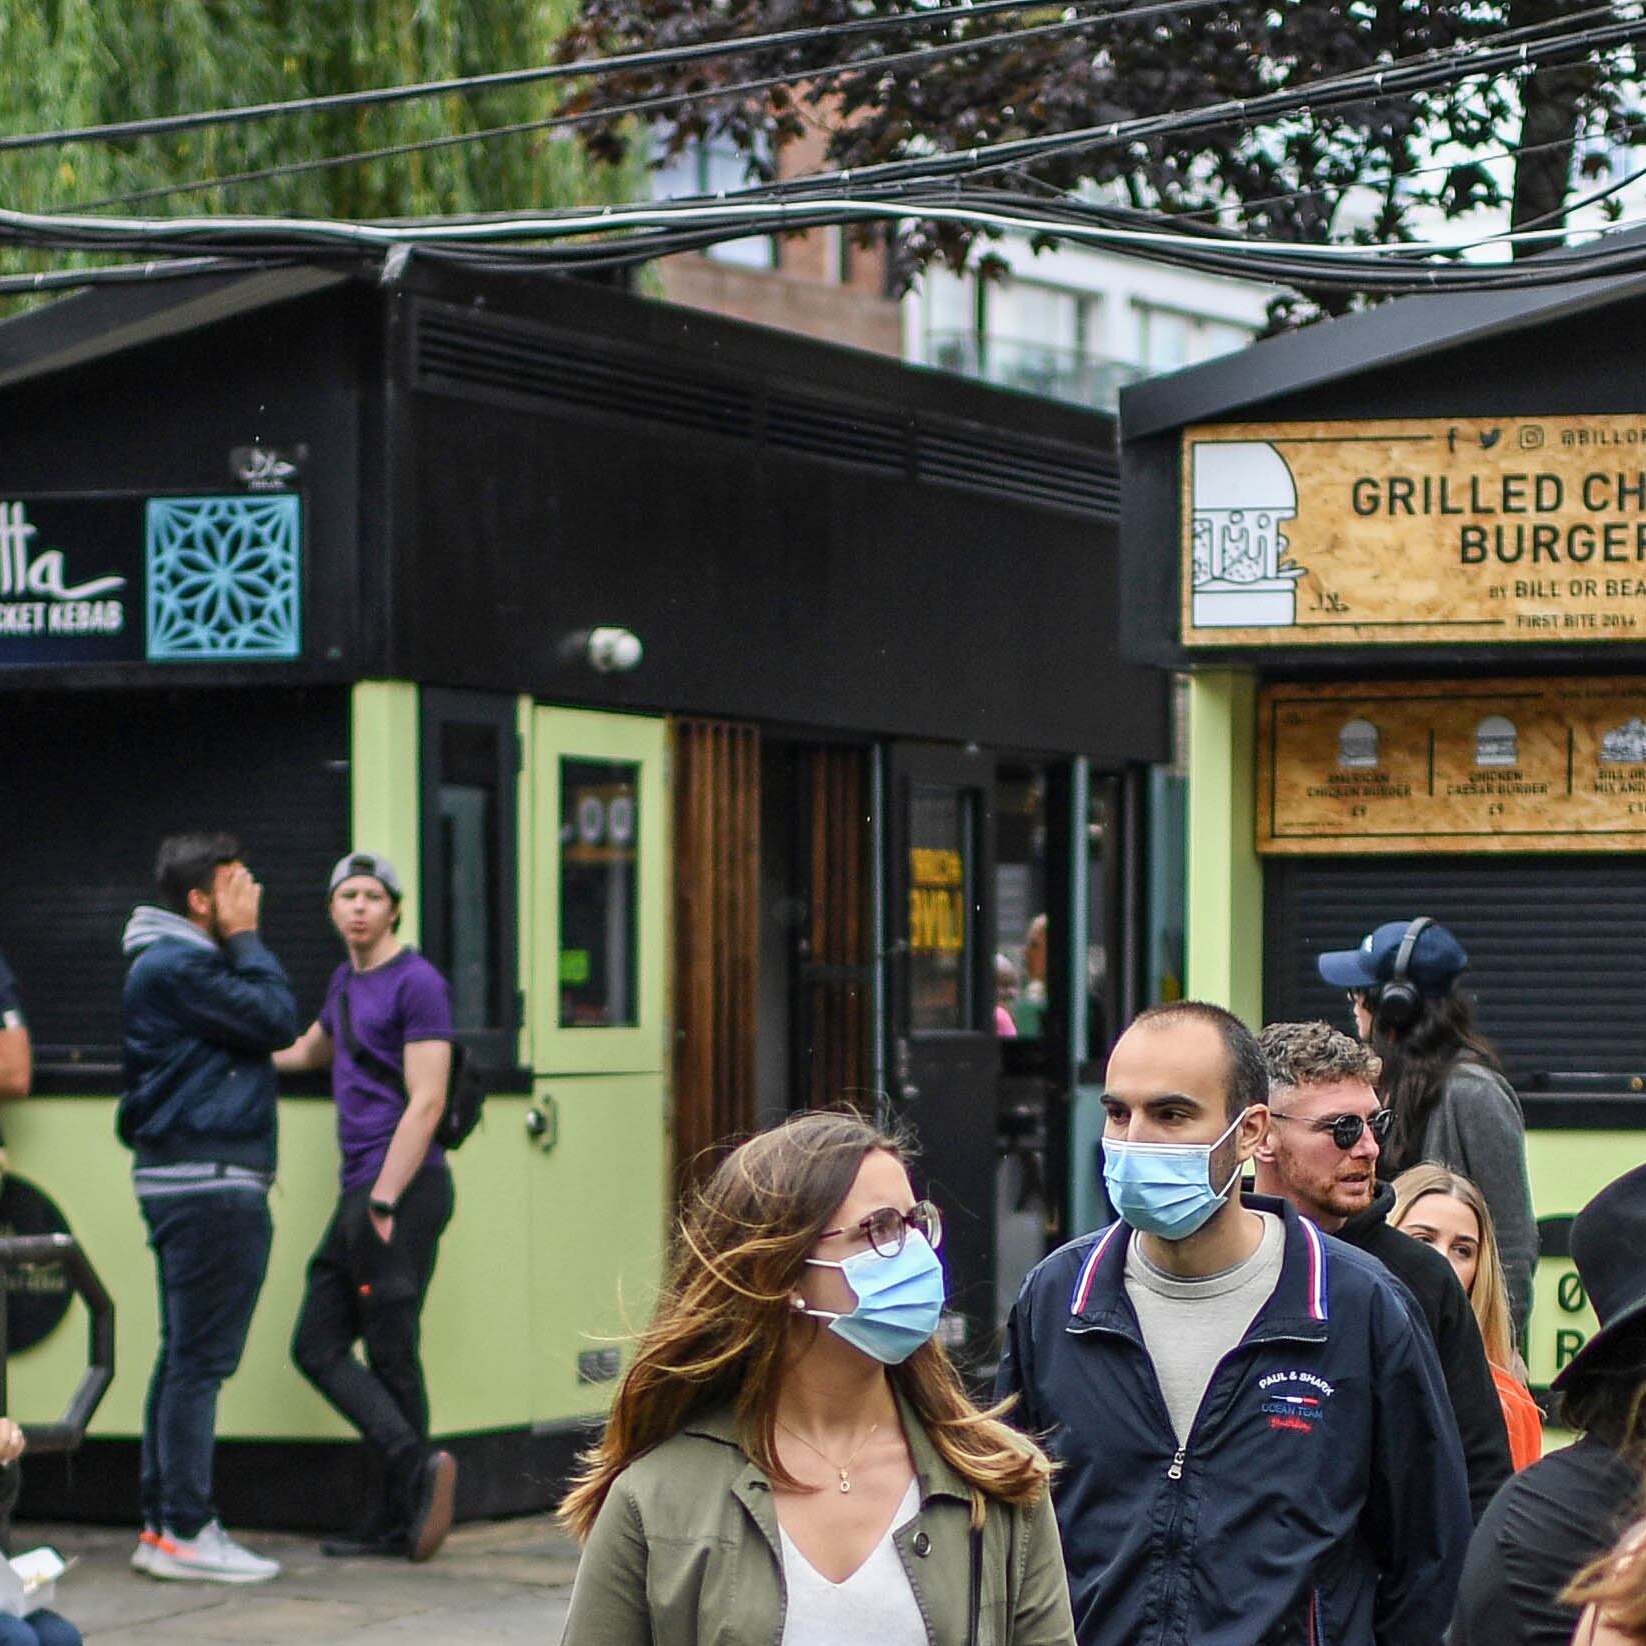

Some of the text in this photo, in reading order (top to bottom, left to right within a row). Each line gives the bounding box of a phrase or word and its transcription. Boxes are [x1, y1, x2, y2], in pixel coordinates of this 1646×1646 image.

[1353, 472, 1565, 517] GRILLED
[1489, 585, 1507, 599] BY
[1515, 579, 1561, 598] BILL
[1569, 579, 1598, 597] OR
[48, 600, 124, 633] KEBAB
[1517, 614, 1559, 629] FIRST
[1564, 613, 1596, 628] BITE
[1258, 1370, 1335, 1397] PAUL & SHARK
[1261, 1403, 1323, 1419] OCEAN TEAM
